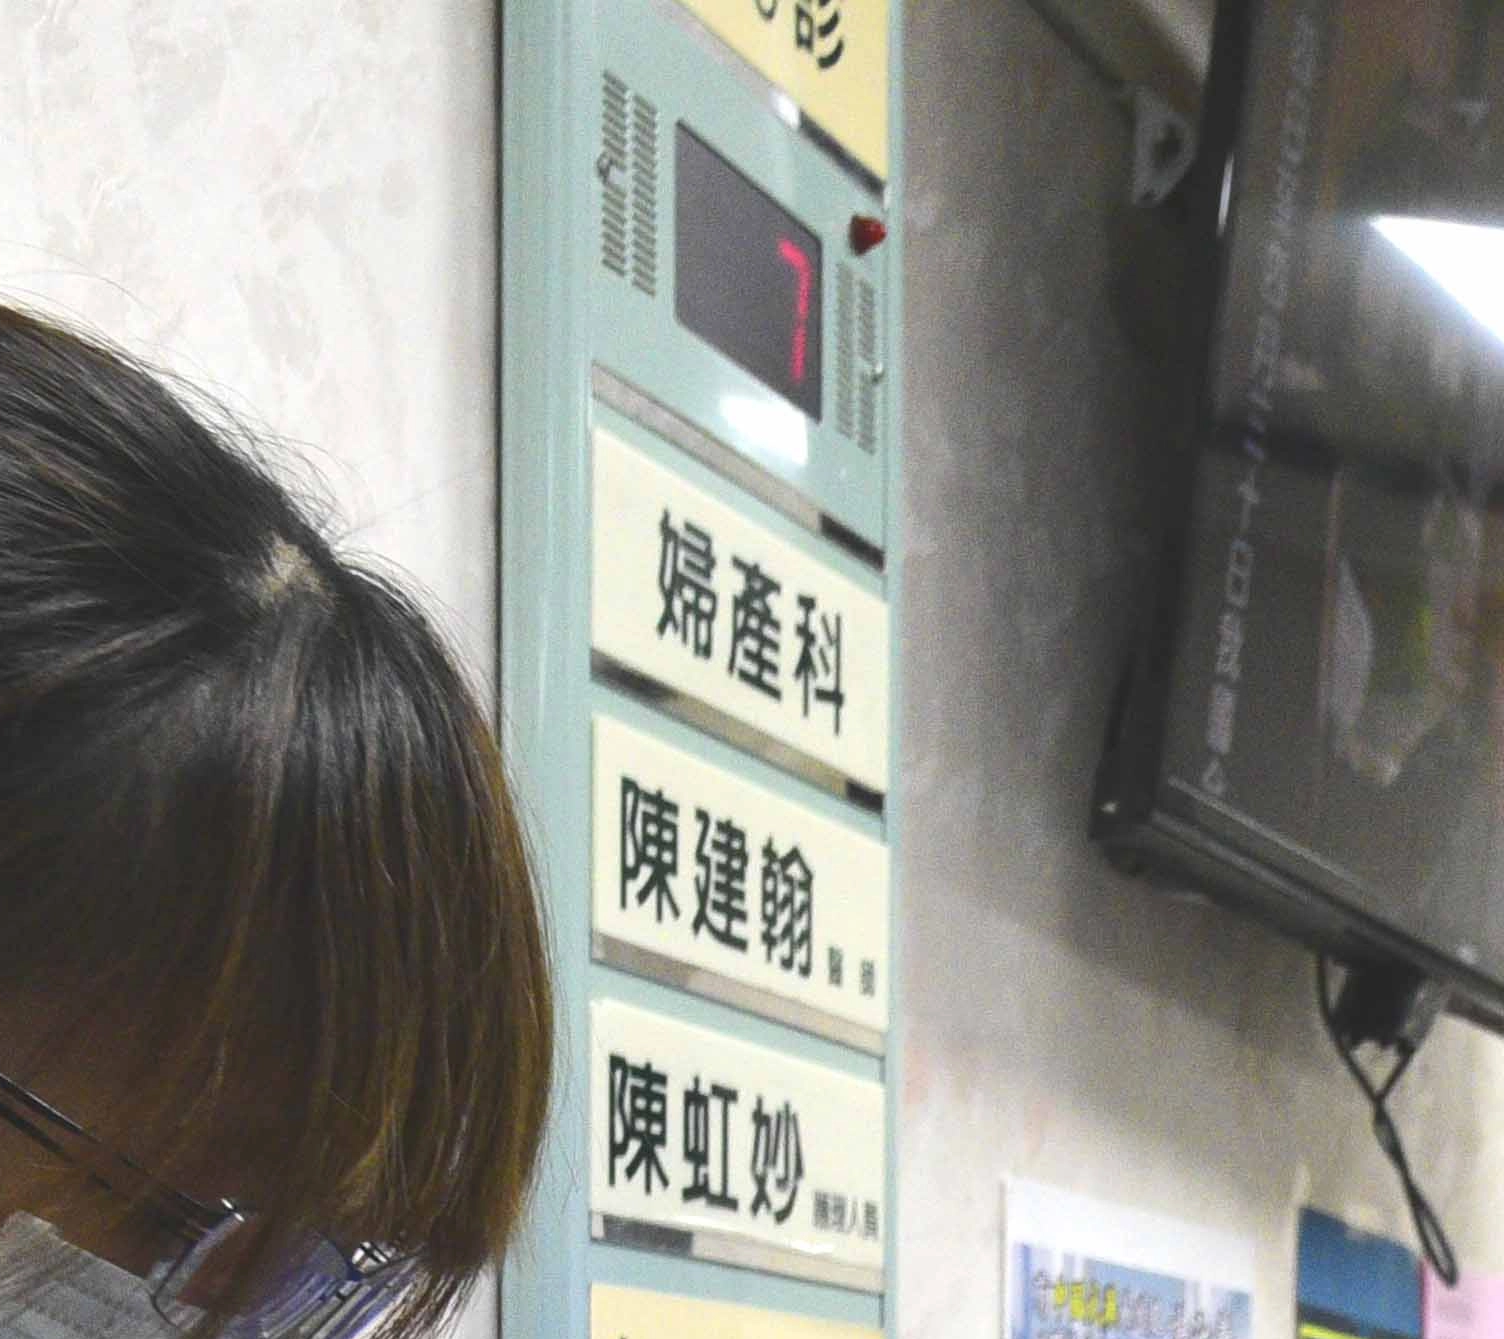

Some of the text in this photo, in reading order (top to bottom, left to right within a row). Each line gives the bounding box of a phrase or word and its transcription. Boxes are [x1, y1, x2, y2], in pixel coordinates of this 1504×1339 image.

[656, 507, 844, 736] 婦產科
[618, 776, 814, 980] 陳建翰
[607, 1052, 805, 1224] 陳虹妙
